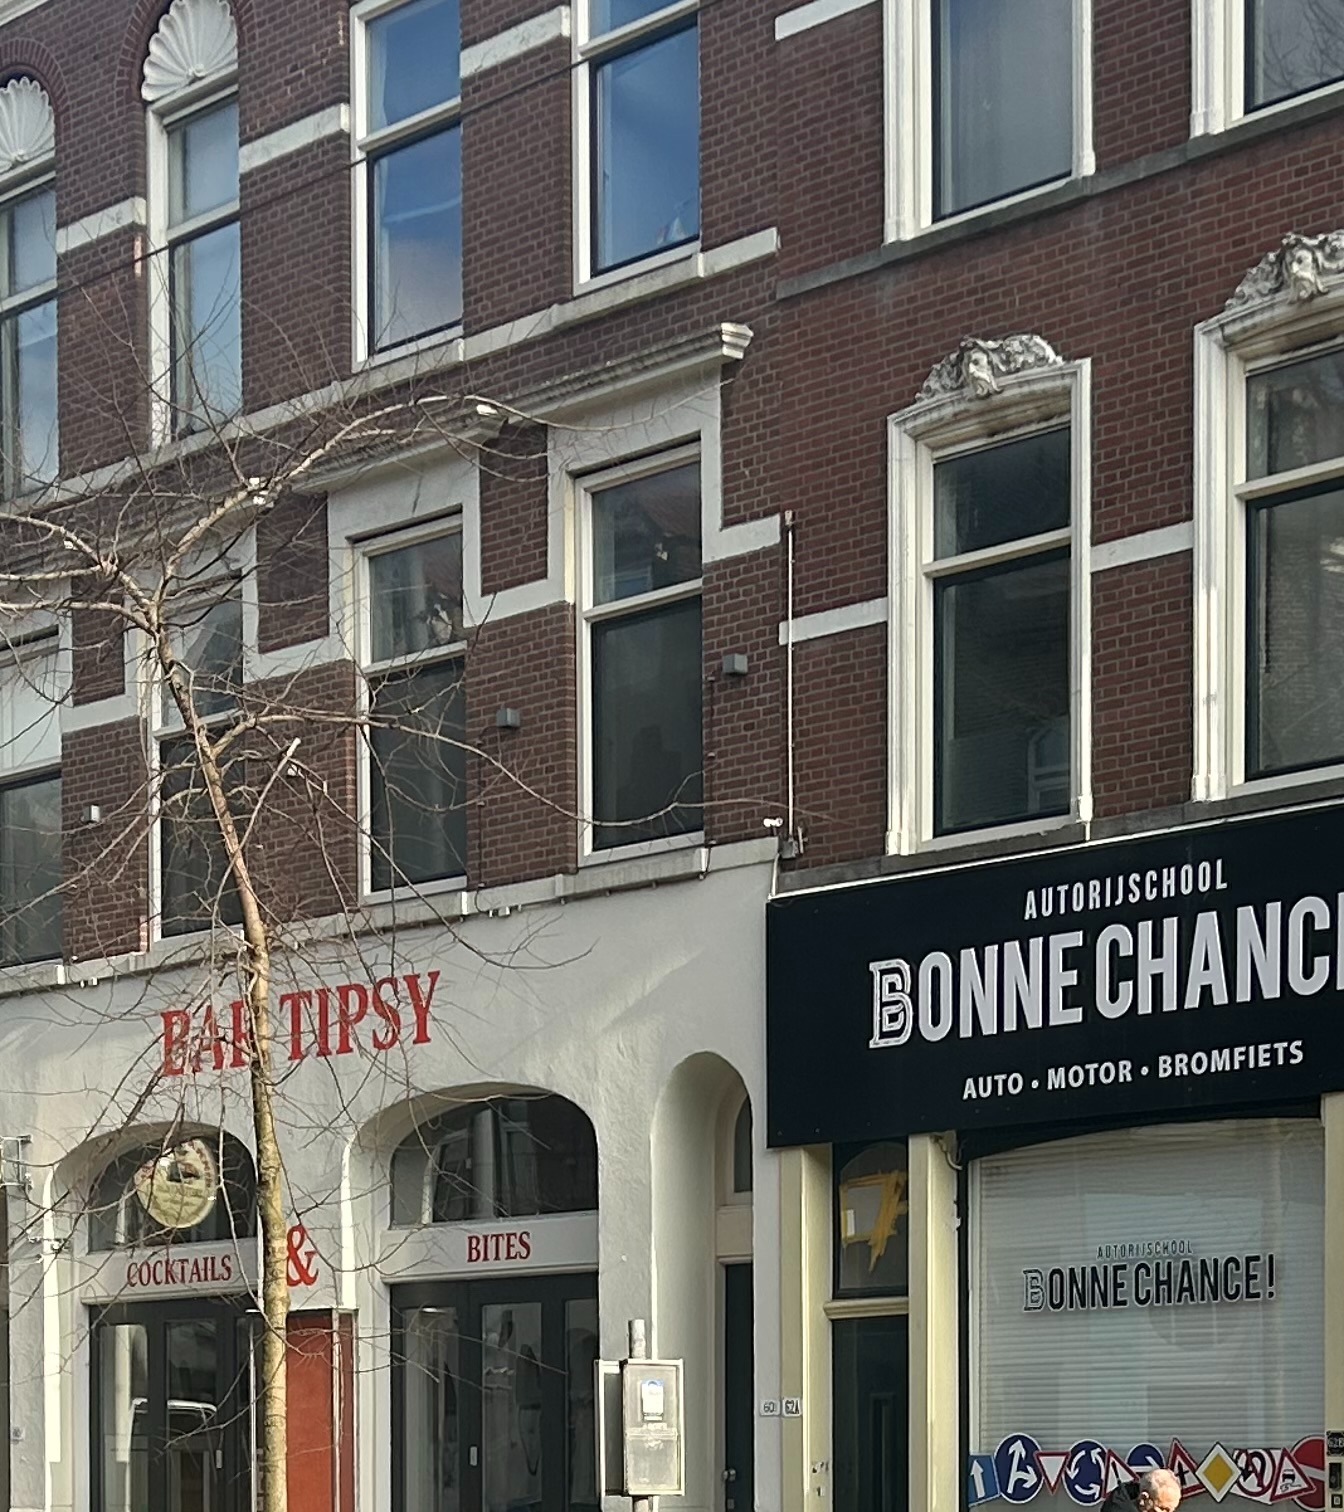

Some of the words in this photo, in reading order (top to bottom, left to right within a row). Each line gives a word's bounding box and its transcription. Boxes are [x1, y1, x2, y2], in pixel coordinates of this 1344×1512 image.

[1023, 858, 1228, 921] AUTORIJSCHOOL
[278, 969, 441, 1061] TIPSY
[868, 929, 1084, 1050] BONNE
[962, 1072, 1024, 1101] AUTO
[1047, 1060, 1133, 1091] MOTOR
[1158, 1040, 1305, 1080] BROMFIETS
[126, 1254, 232, 1288] COCKTAILS
[466, 1231, 532, 1264] BITES
[1096, 1239, 1193, 1260] AUTORIJSCHOOL
[1022, 1263, 1128, 1312] BONNE
[1133, 1253, 1276, 1307] CHANCE!
